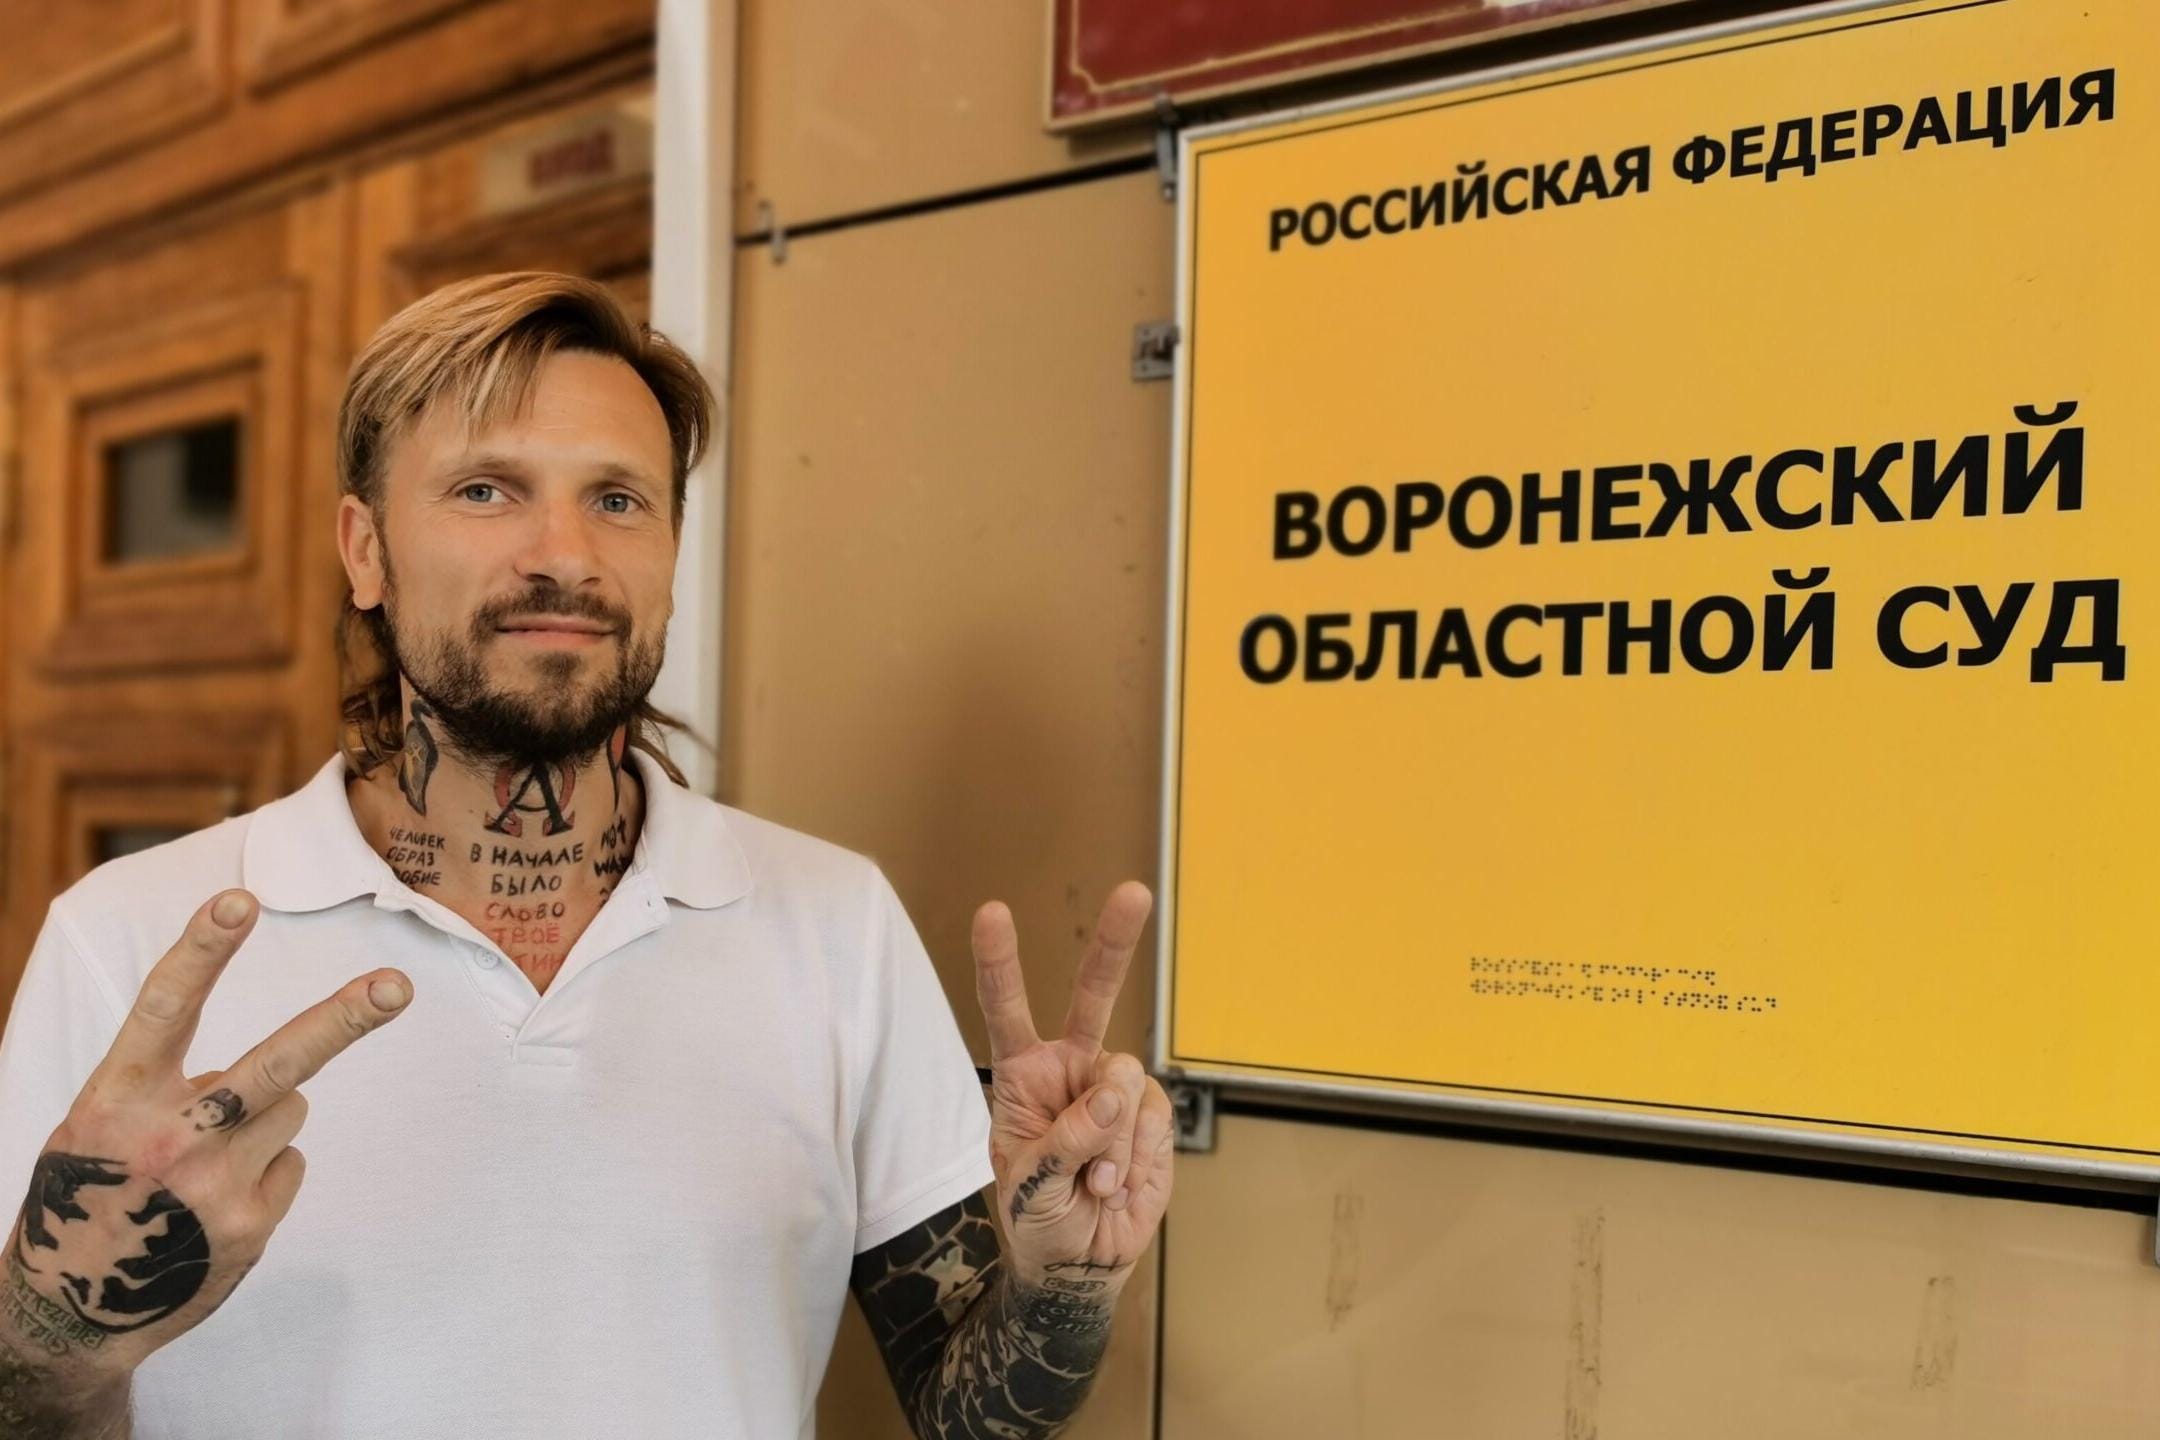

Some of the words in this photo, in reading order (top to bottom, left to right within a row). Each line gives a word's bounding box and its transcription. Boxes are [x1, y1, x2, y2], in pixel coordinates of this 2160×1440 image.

[1269, 145, 1651, 252] РОССИЙСКАЯ
[1672, 68, 2115, 185] ФЕДЕРАЦИЯ
[1272, 400, 2084, 560] ВОРОНЕЖСКИЙ
[1239, 566, 1836, 685] ОБЛАСТНОЙ
[1876, 578, 2126, 683] СУД
[386, 846, 435, 867] ОБРАЗ
[492, 842, 584, 868] НАЧАЛЕ
[491, 873, 562, 897] БЫЛО
[486, 902, 566, 922] СЛОВО
